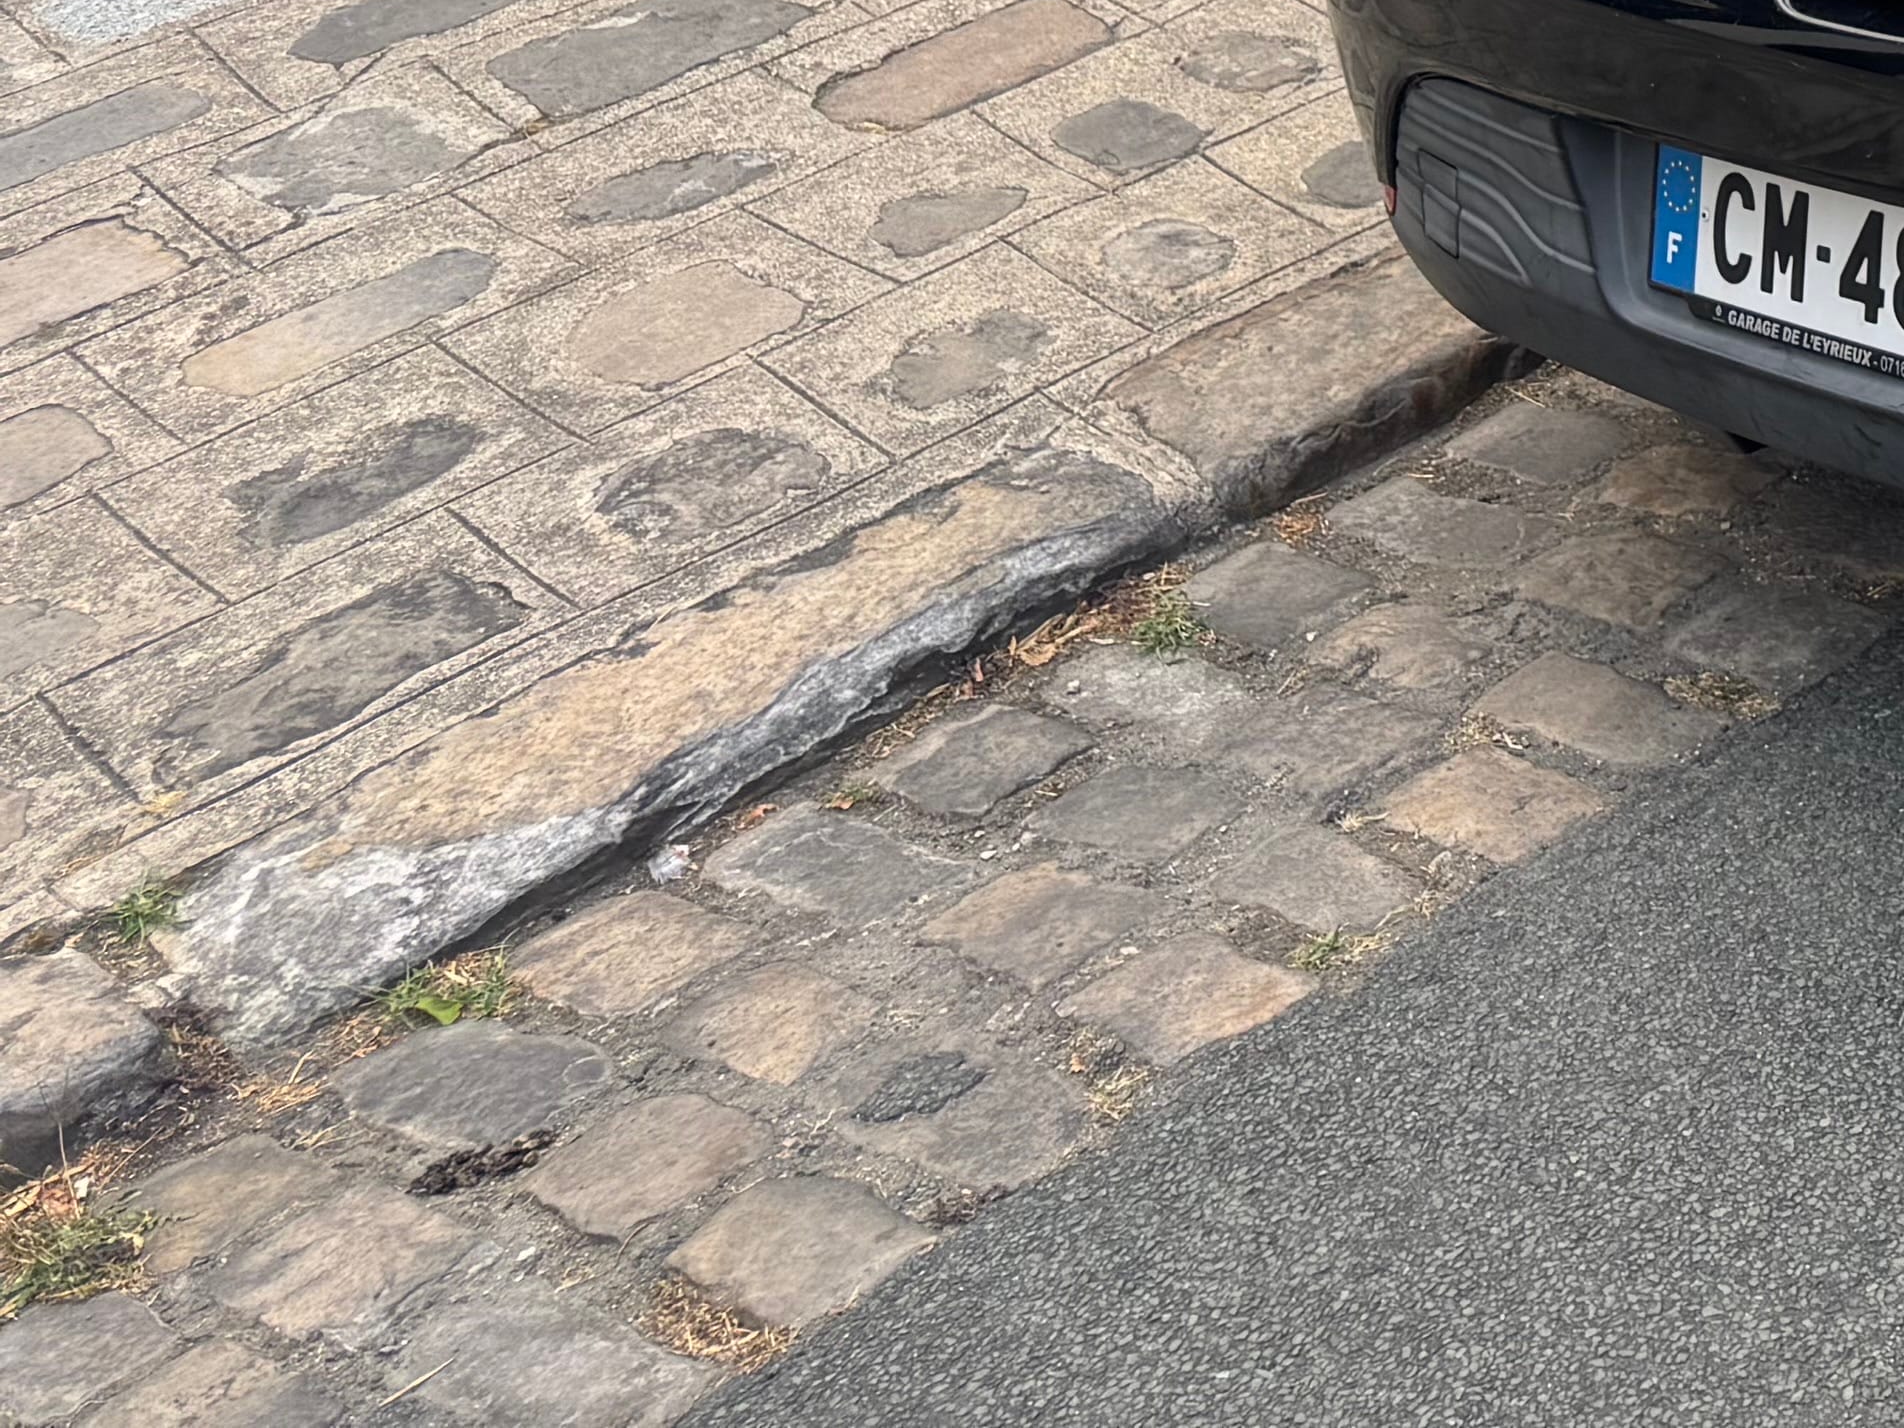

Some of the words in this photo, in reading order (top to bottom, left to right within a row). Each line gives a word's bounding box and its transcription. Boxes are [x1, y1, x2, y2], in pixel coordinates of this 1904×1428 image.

[1666, 230, 1683, 264] F
[1727, 310, 1780, 339] GARAGE
[1782, 326, 1800, 346] DE
[1803, 331, 1873, 367] L'EYRIEUX
